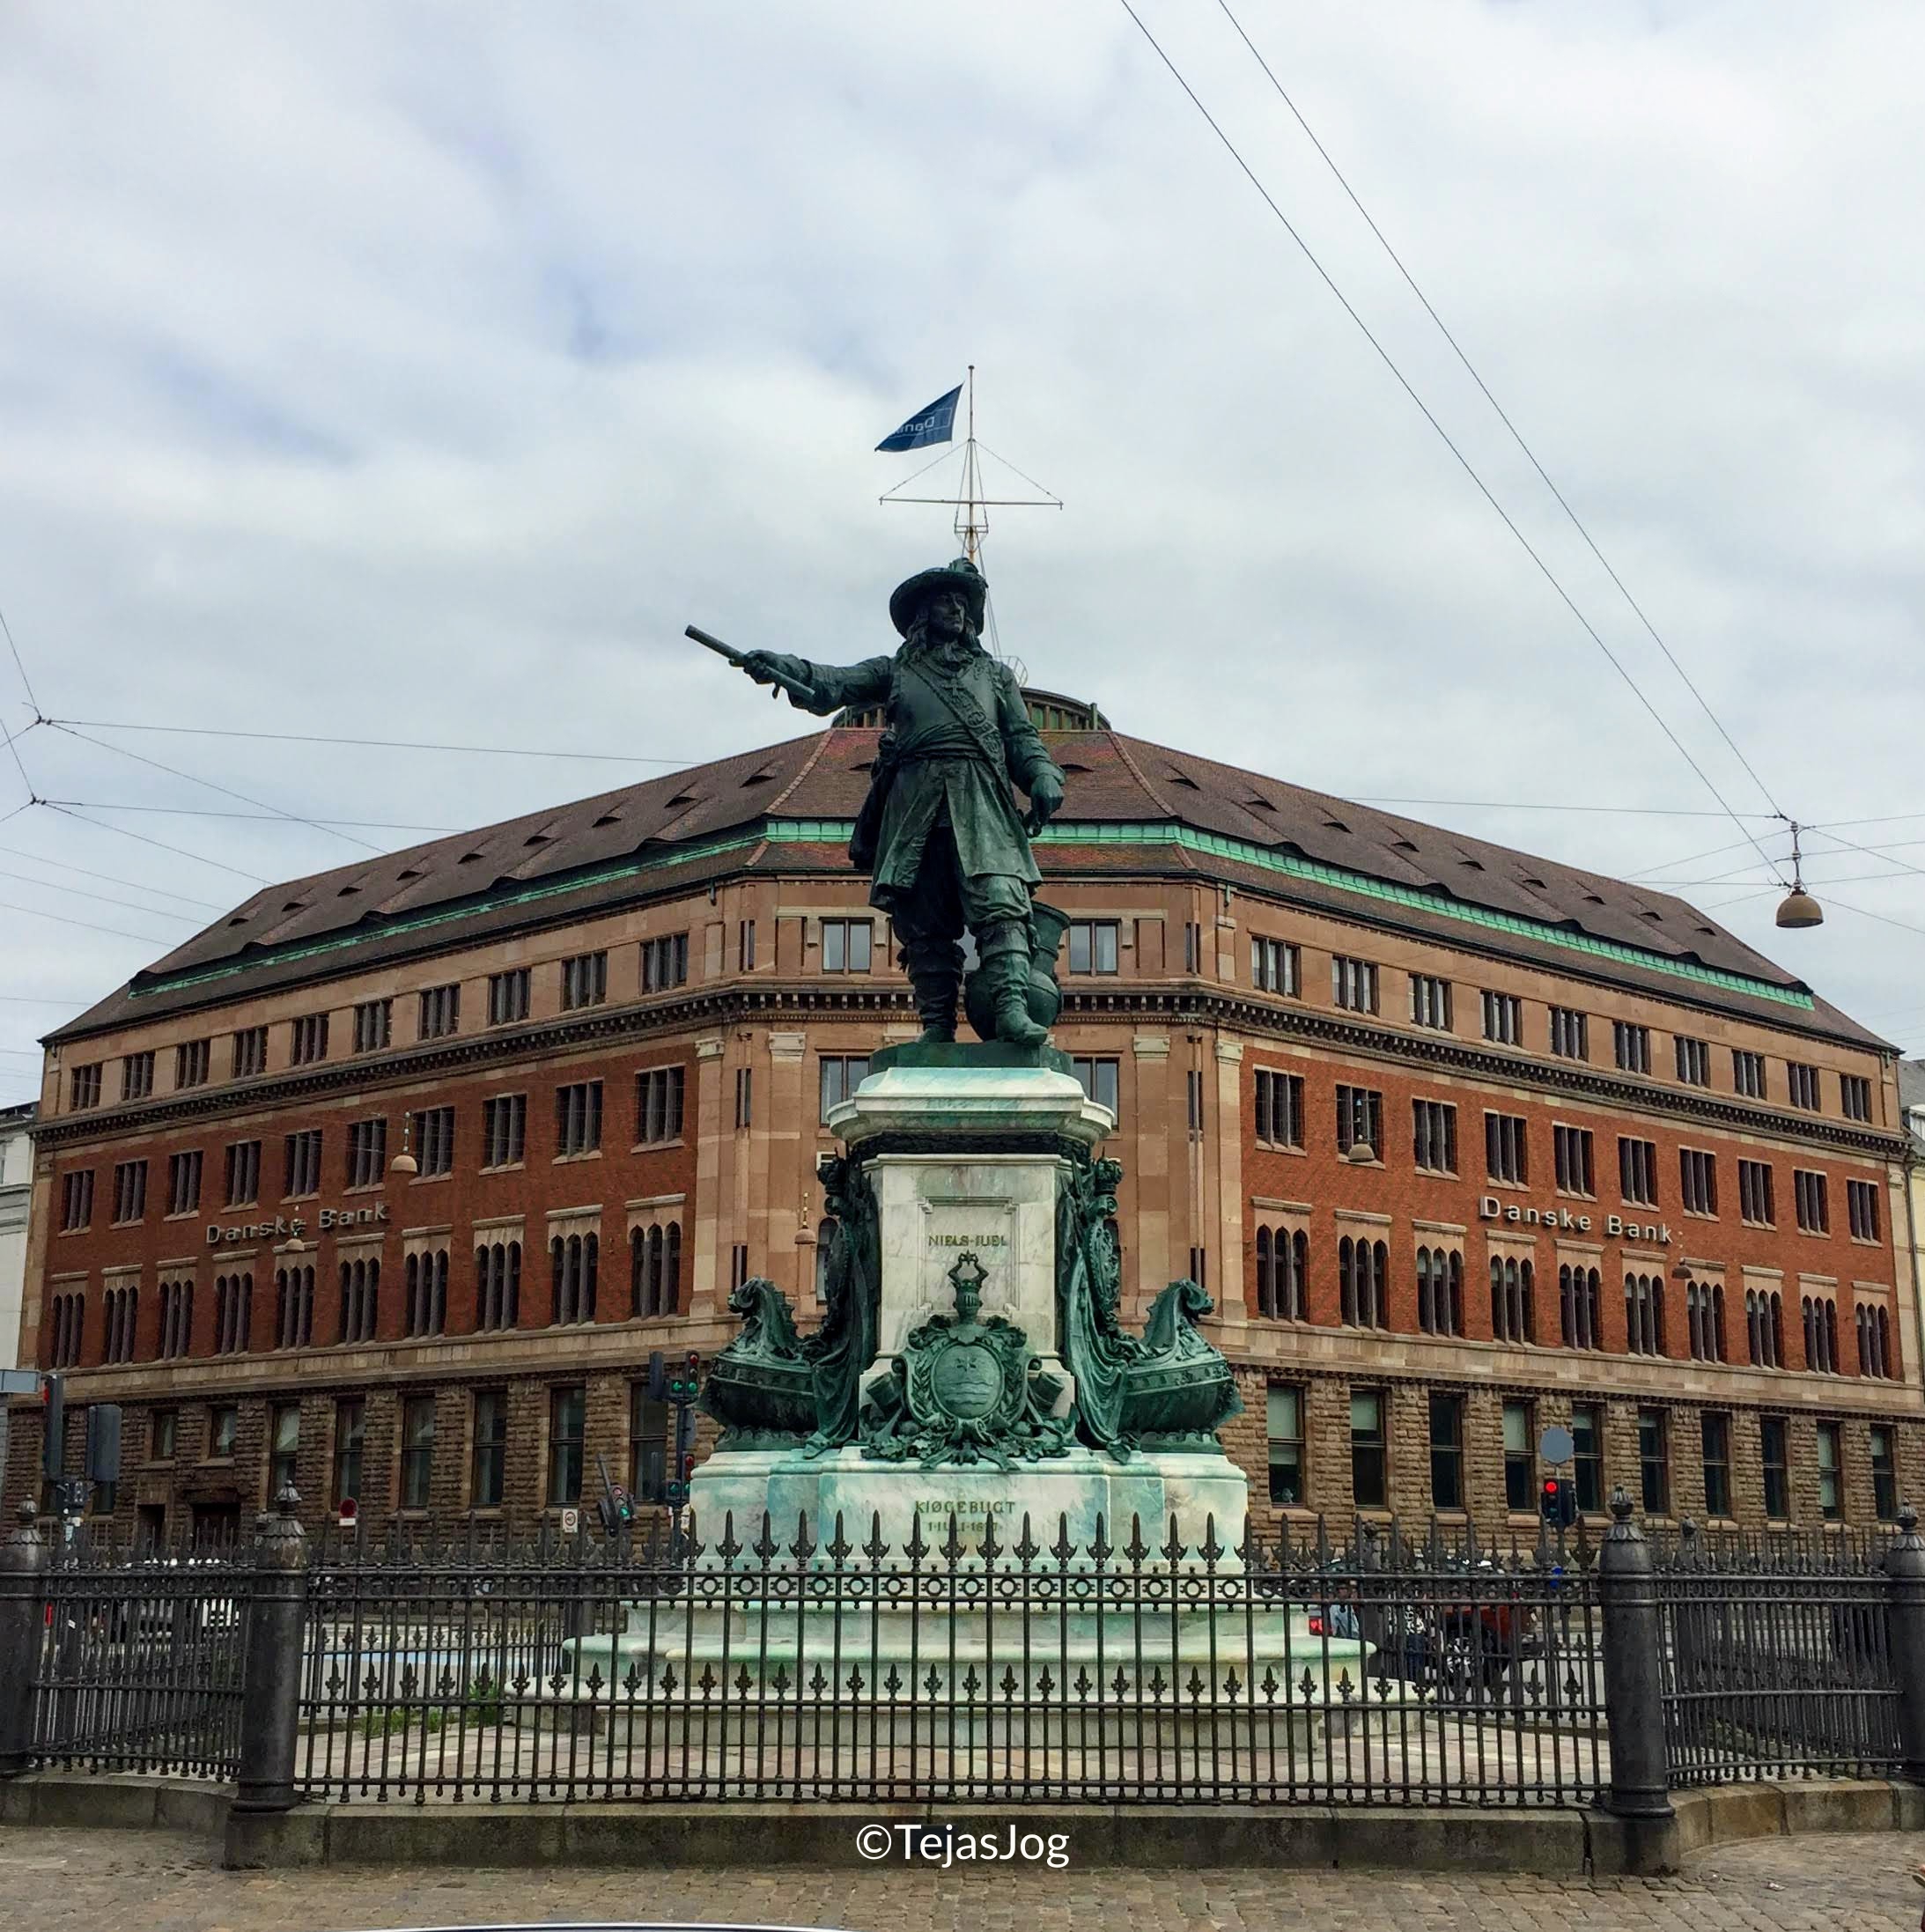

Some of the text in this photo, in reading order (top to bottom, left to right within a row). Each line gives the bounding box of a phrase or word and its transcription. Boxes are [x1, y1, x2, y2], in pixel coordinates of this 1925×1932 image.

[206, 1202, 388, 1244] Danske Bank
[1479, 1196, 1673, 1243] Danske Bank
